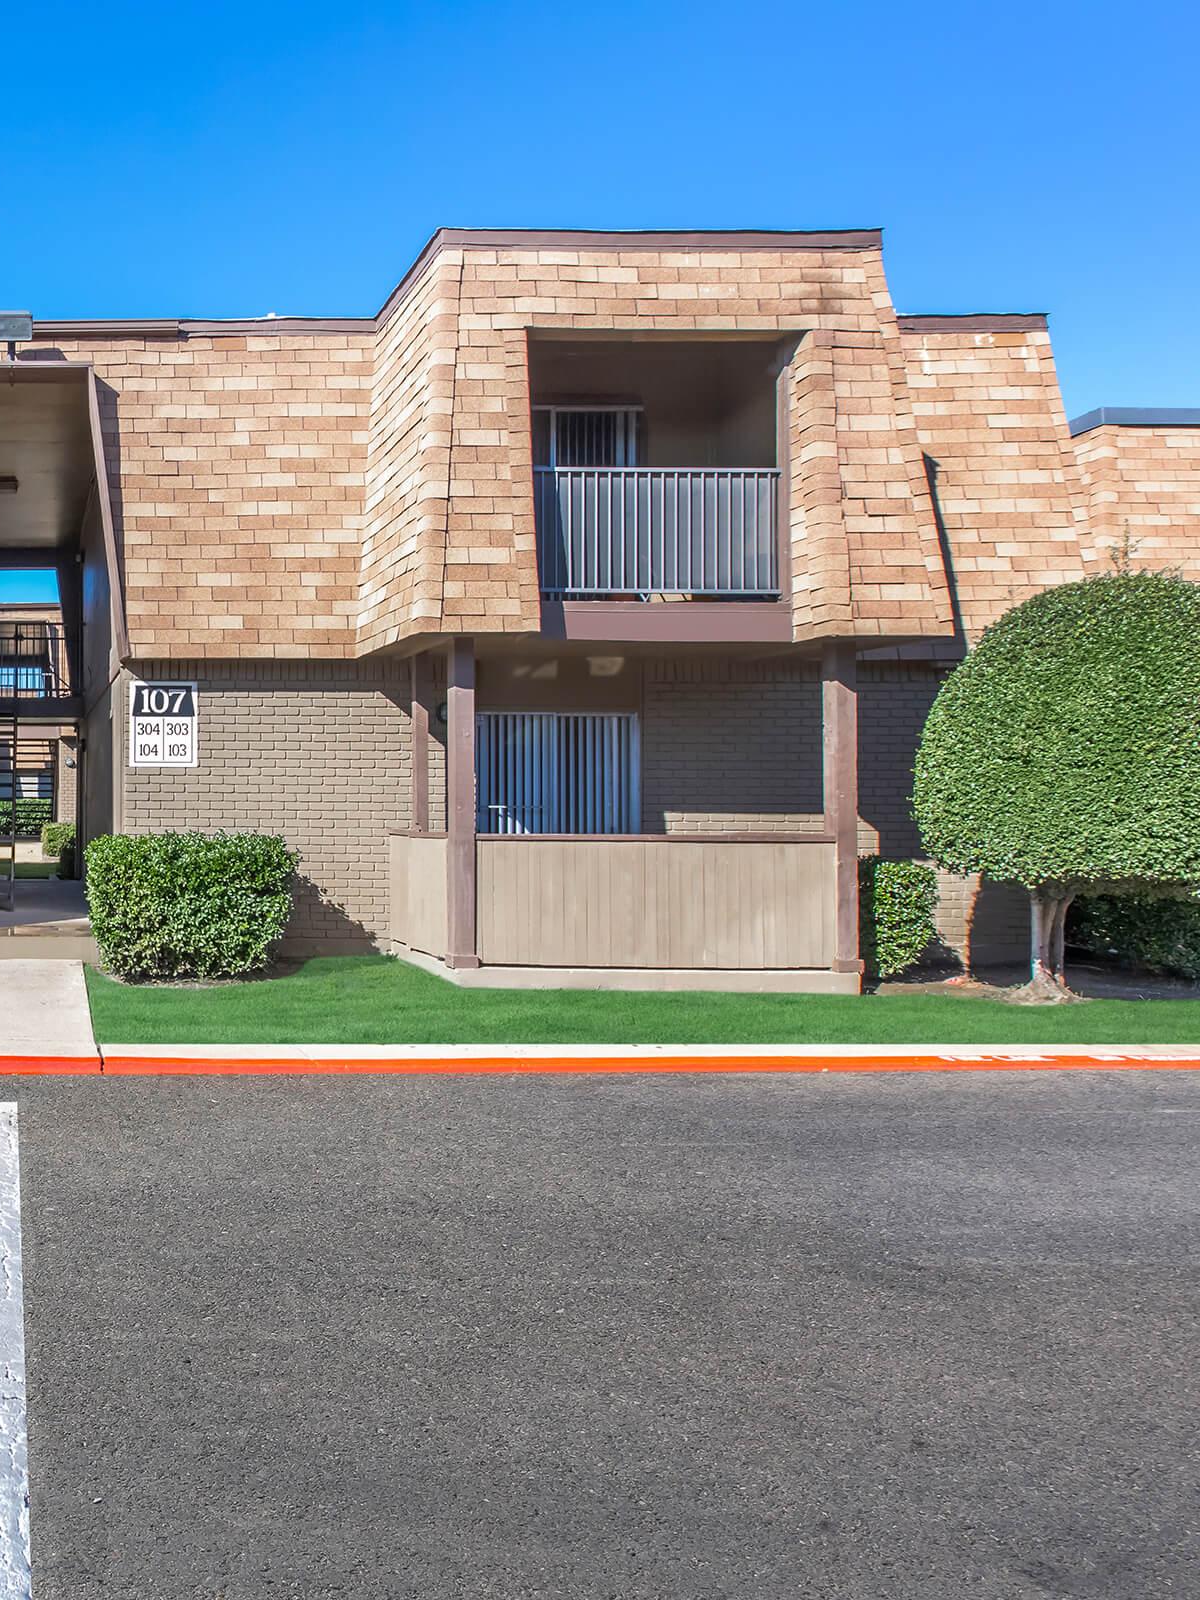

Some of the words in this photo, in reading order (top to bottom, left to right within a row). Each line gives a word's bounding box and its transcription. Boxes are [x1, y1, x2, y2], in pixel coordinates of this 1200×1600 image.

[141, 689, 187, 713] 107
[137, 723, 160, 735] 304
[166, 723, 189, 735] 303
[139, 744, 158, 757] 104
[168, 744, 187, 757] 103
